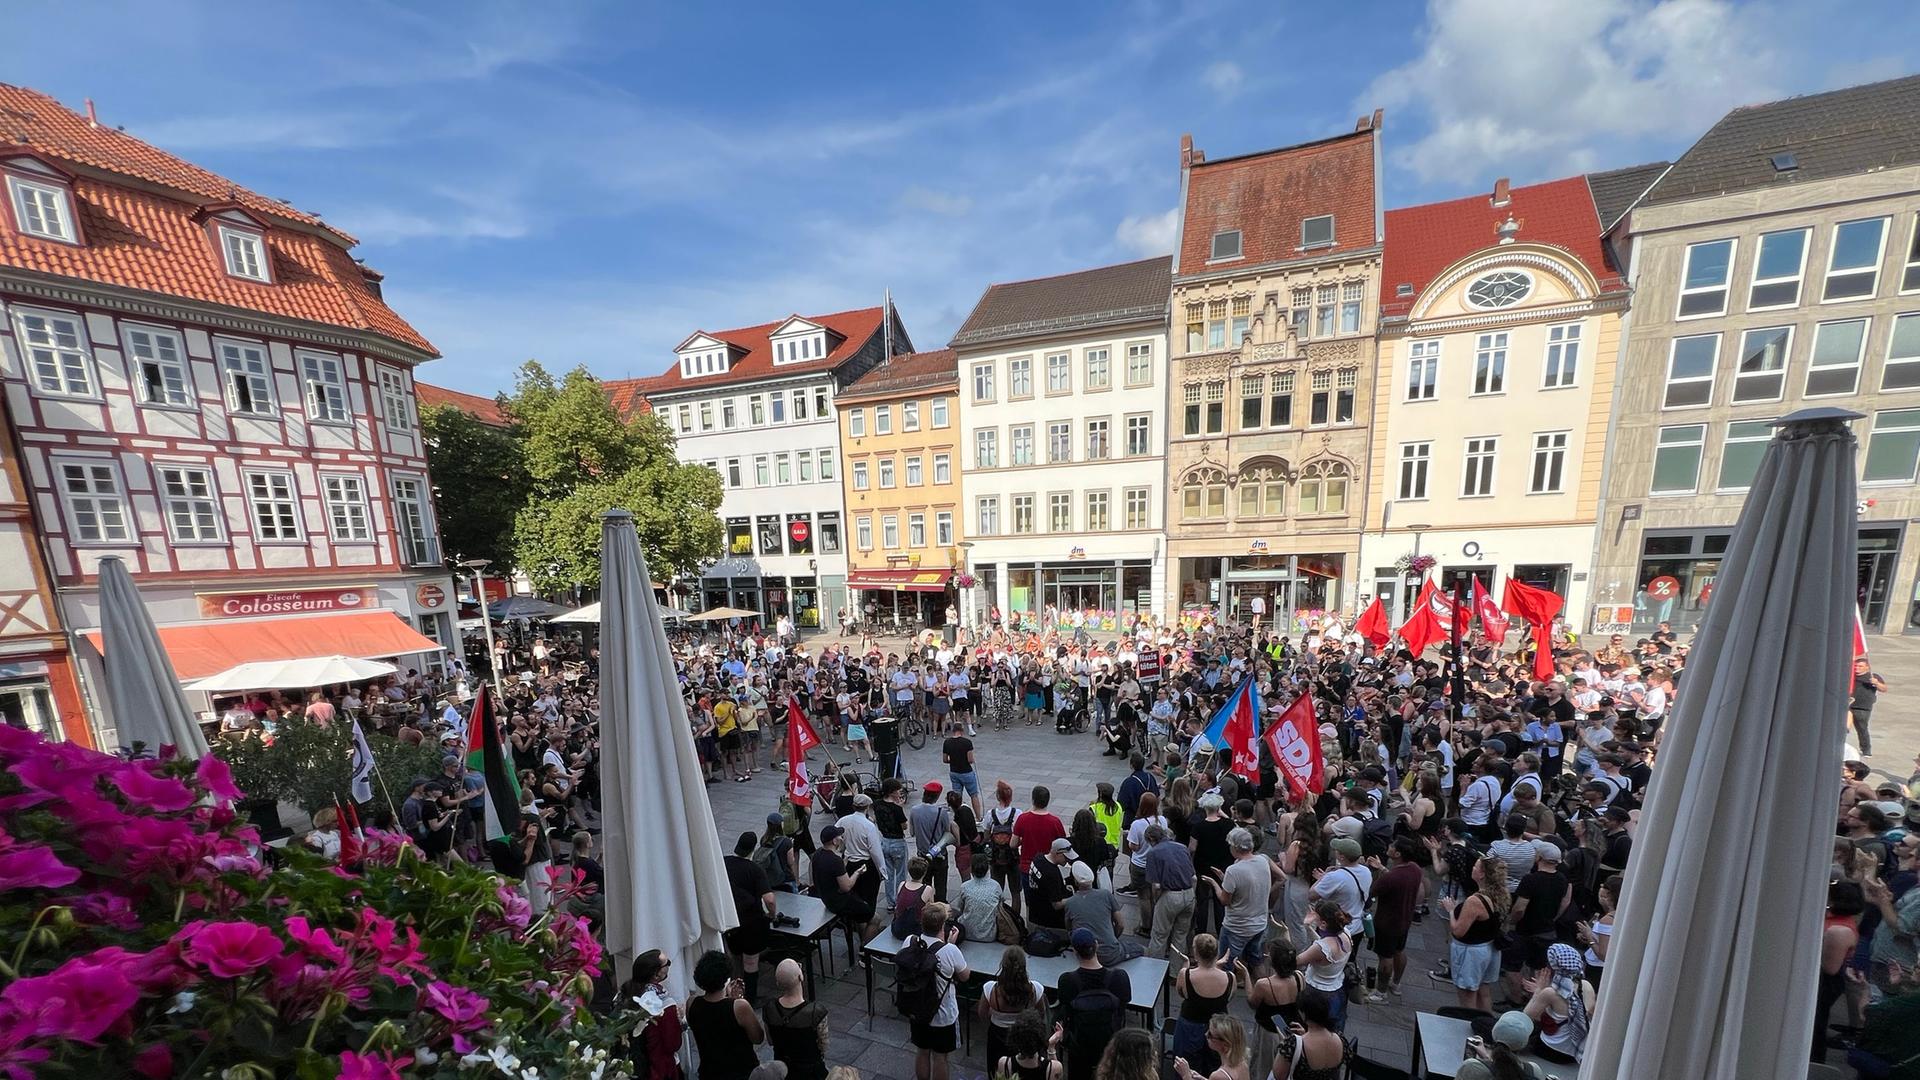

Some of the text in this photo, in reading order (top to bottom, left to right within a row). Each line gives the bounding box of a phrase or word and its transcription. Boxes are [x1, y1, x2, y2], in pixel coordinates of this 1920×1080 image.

[1252, 540, 1267, 549] dm
[1071, 546, 1084, 554] dm
[223, 598, 333, 615] Colosseum
